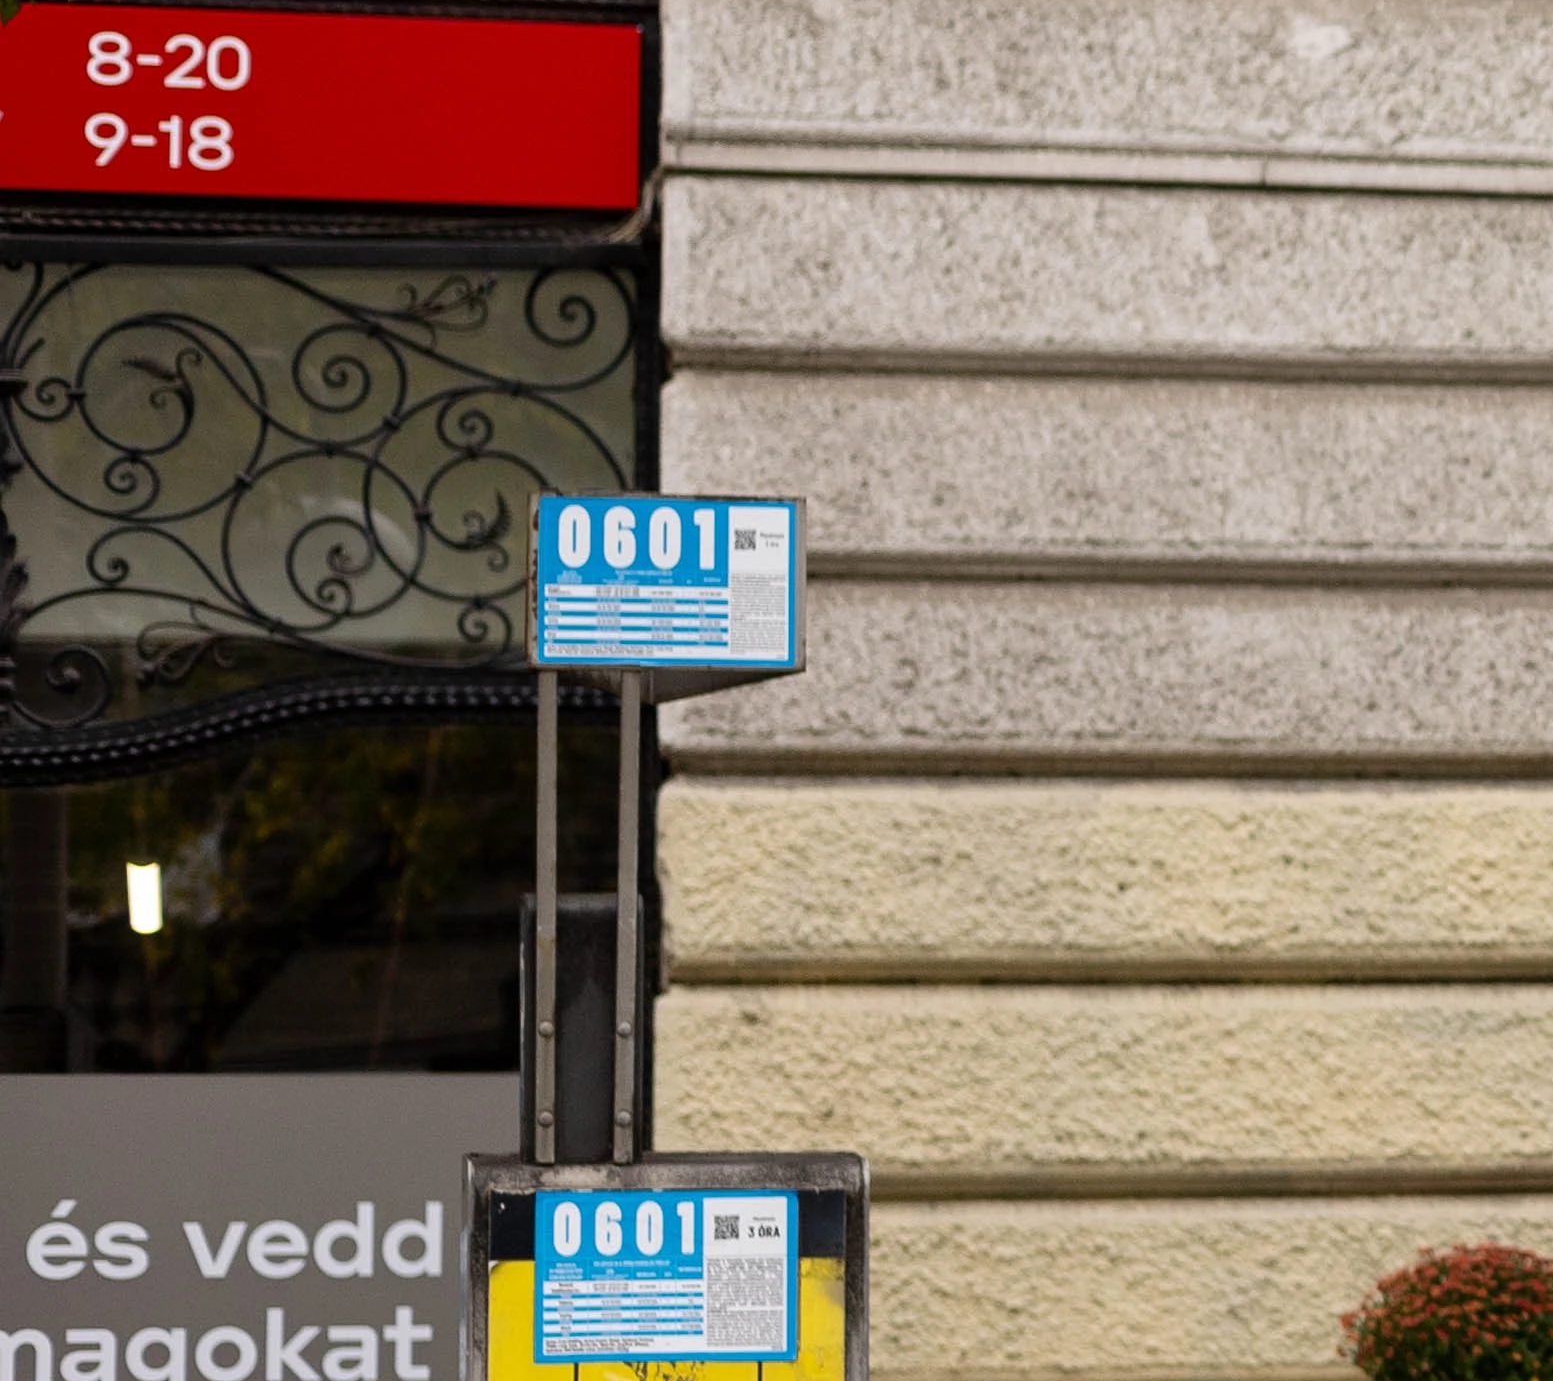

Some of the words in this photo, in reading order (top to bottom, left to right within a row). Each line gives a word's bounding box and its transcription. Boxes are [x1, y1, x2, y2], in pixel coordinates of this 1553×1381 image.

[86, 31, 251, 91] 8-20
[84, 112, 235, 171] 9-18
[558, 504, 715, 569] 0601
[26, 1199, 149, 1280] és
[183, 1201, 443, 1279] vedd
[553, 1200, 695, 1257] 0601
